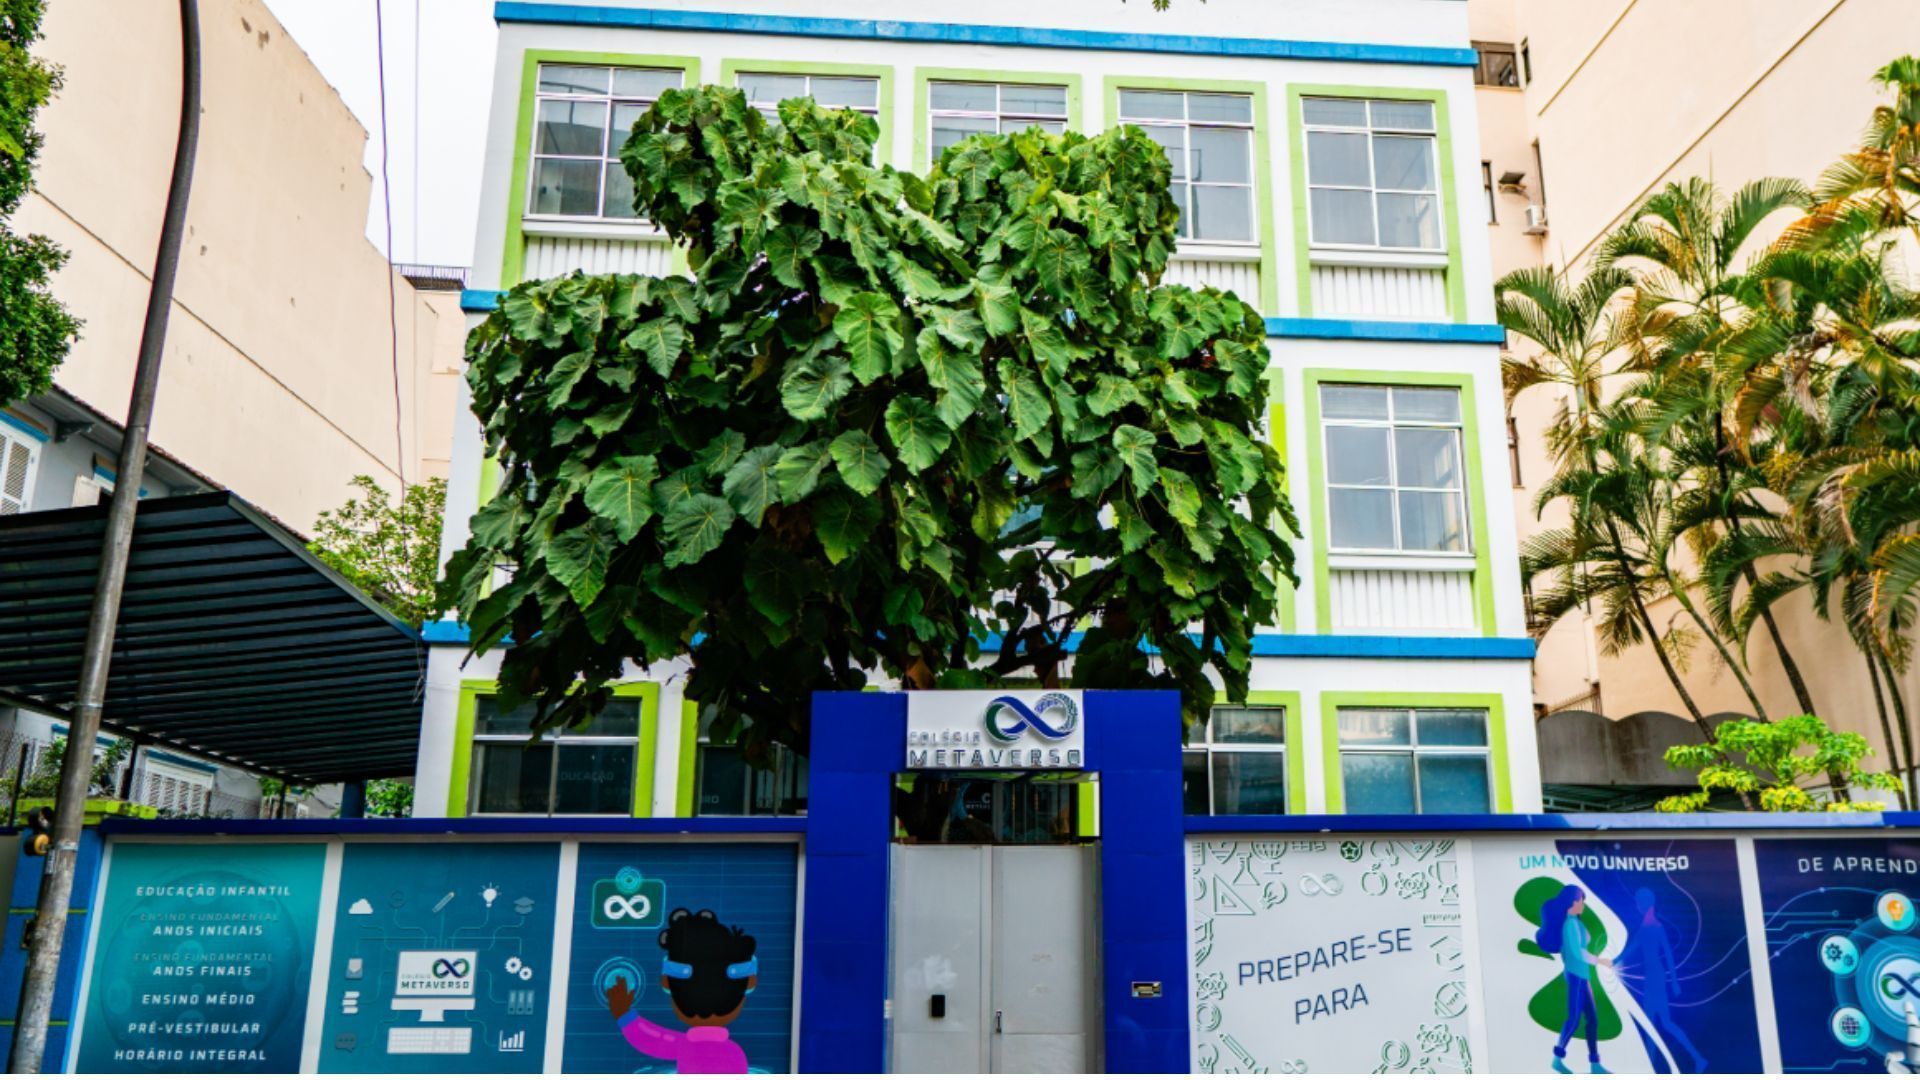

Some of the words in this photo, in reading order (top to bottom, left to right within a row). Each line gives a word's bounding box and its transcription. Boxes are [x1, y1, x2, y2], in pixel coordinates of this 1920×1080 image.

[909, 749, 1081, 768] METAVERSO
[1519, 855, 1546, 870] UM
[1550, 854, 1600, 870] NOVO
[1602, 855, 1690, 872] UNIVERSO
[1798, 857, 1824, 873] DE
[1833, 856, 1918, 874] APREND
[136, 884, 215, 897] EDUCAÇÃO
[221, 885, 291, 897] INFANTIL
[140, 912, 186, 922] ENSINO
[190, 912, 279, 922] FUNDAMENTAL
[153, 925, 195, 936] ANOS
[200, 925, 263, 936] INICIAIS
[133, 953, 181, 962] ENSINO
[184, 952, 273, 962] FUNDAMENTAL
[1238, 928, 1412, 986] PREPARE-SE
[153, 966, 195, 976] ANOS
[200, 966, 252, 976] FINAIS
[401, 981, 470, 989] METAVERSO
[142, 994, 199, 1005] ENSINO
[206, 991, 256, 1005] MÉDIO
[1294, 983, 1369, 1024] PARA
[128, 1021, 261, 1034] PRÉ-VESTIBULAR
[114, 1049, 183, 1061] HORÁRIO
[190, 1050, 267, 1060] INTEGRAL
